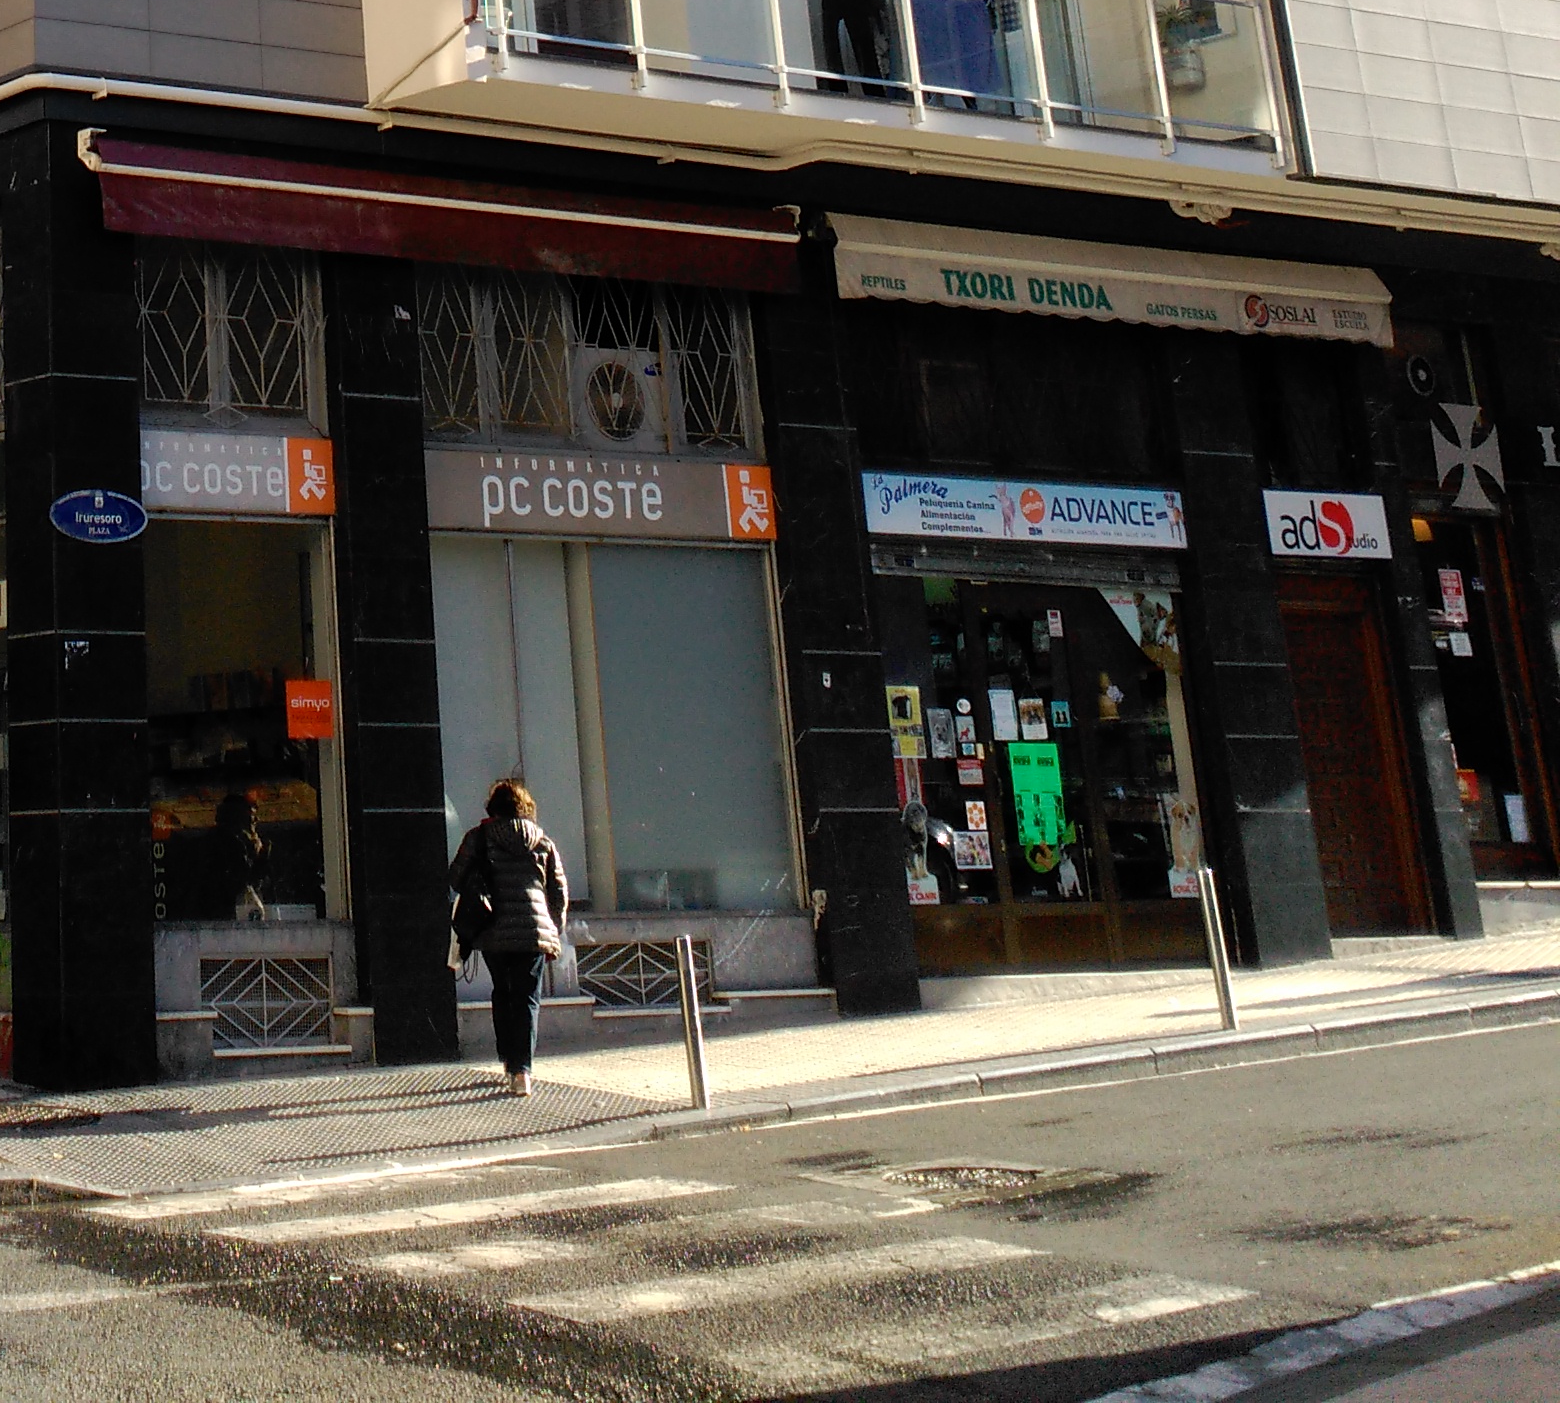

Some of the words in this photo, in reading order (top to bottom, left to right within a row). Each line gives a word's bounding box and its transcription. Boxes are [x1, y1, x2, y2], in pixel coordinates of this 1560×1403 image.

[861, 273, 907, 291] REPTILES
[940, 268, 1016, 301] TXORI
[1027, 277, 1113, 312] DENDA
[1146, 302, 1179, 318] GATOS
[1180, 306, 1217, 322] PERSAS
[143, 441, 282, 456] NFORMATICA
[879, 478, 948, 515] Palmera
[966, 500, 996, 511] Canina
[1050, 496, 1156, 527] ADVANCE
[75, 511, 122, 524] Iruresoro
[88, 527, 111, 535] PLAZA
[291, 695, 330, 712] simyo
